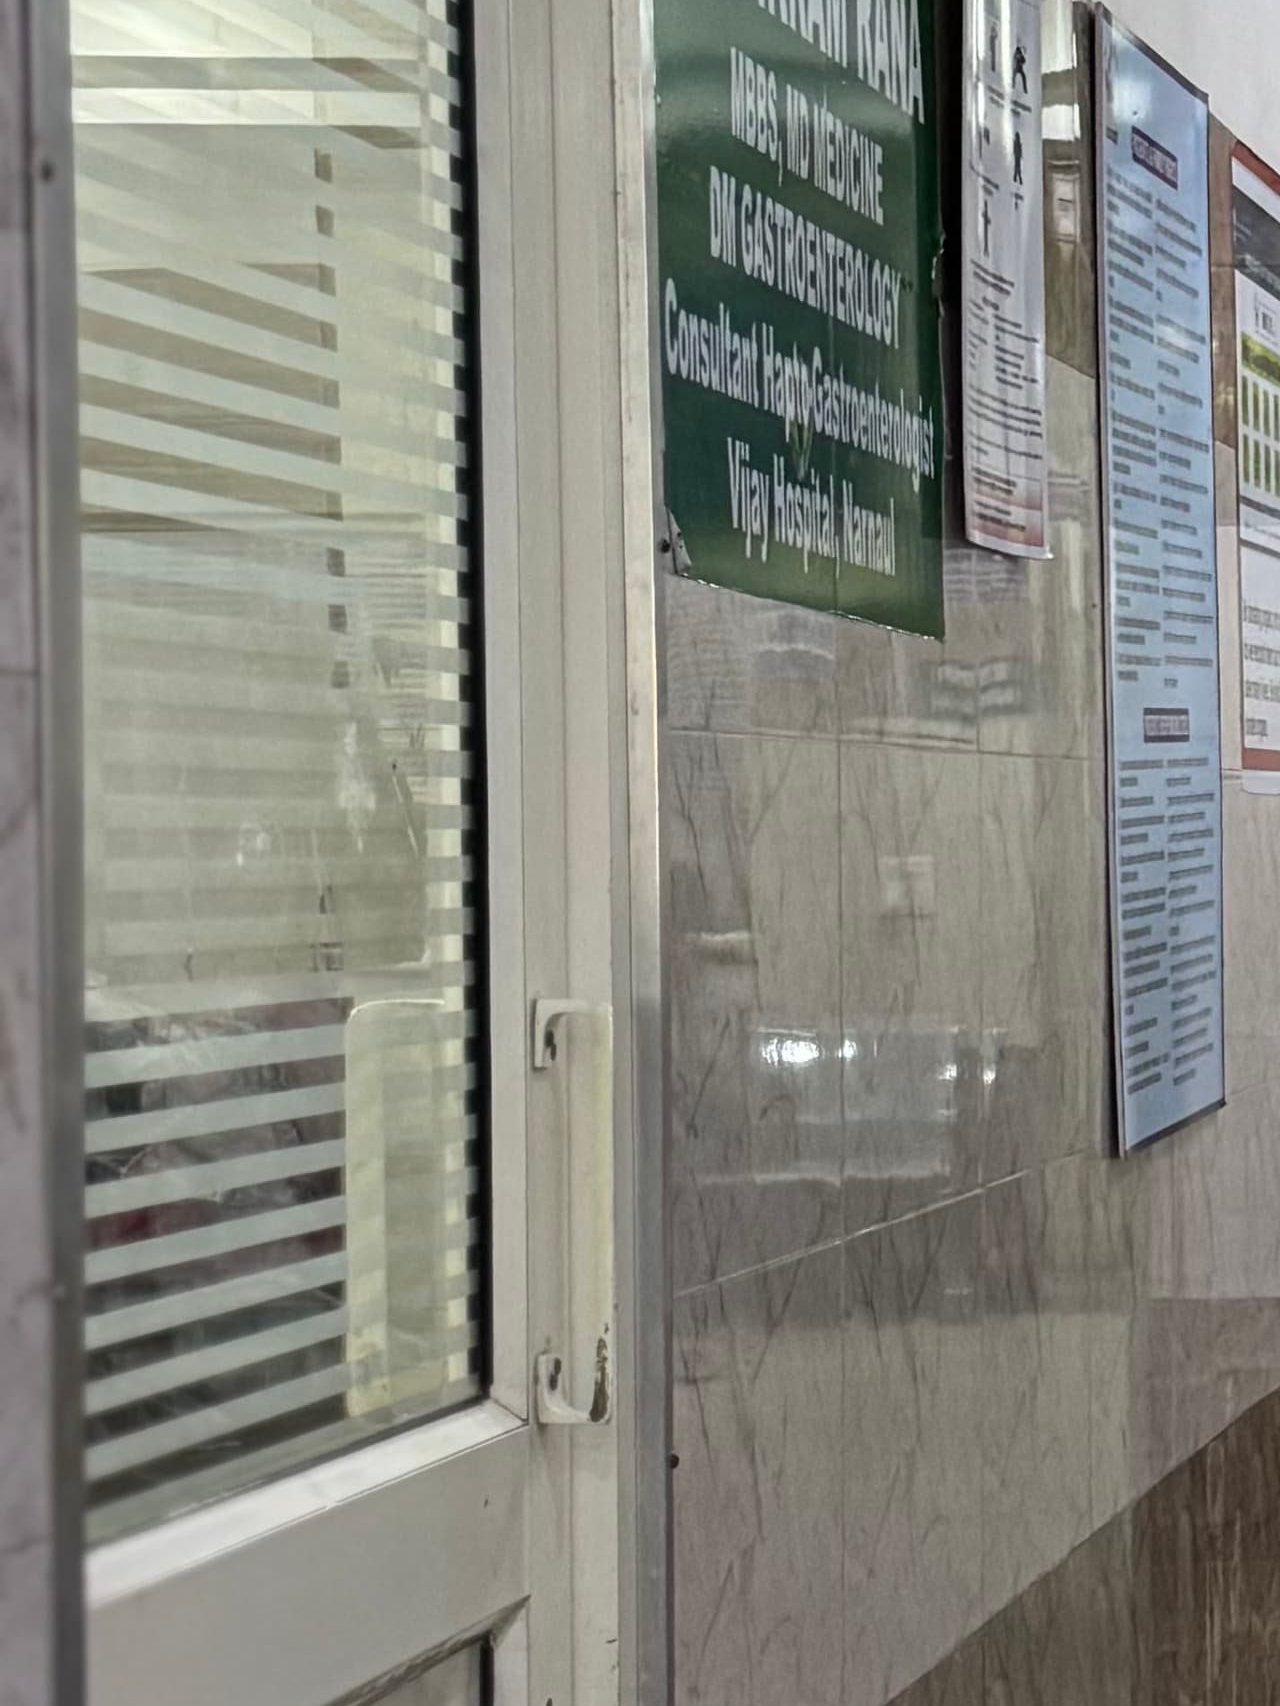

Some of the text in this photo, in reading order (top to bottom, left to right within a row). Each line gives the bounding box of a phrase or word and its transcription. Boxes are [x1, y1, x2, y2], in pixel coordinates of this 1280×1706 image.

[730, 46, 884, 226] MBBS, MD MEDICINE
[710, 166, 902, 350] DM GASTROENTEROLOGY
[664, 277, 759, 409] Consultant
[727, 436, 897, 580] Vijay Hospital, Narnaul
